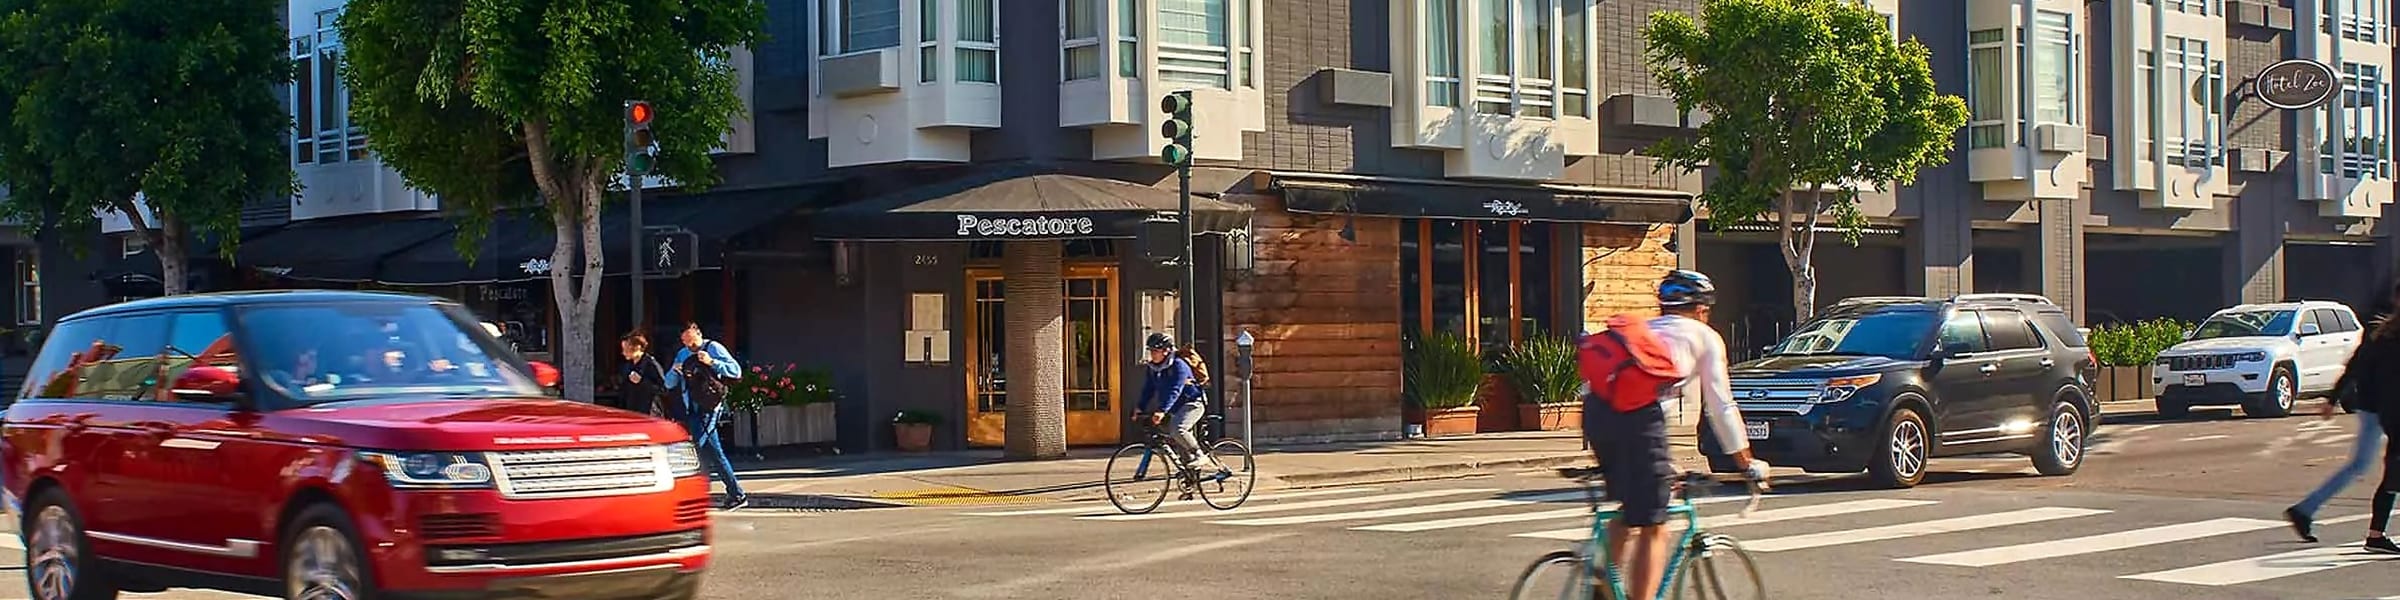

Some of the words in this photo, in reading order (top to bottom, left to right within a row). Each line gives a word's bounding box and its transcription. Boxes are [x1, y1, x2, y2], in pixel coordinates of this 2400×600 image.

[2265, 69, 2302, 95] Hotel
[2303, 73, 2325, 92] Zoe
[957, 214, 1093, 236] Pescatore
